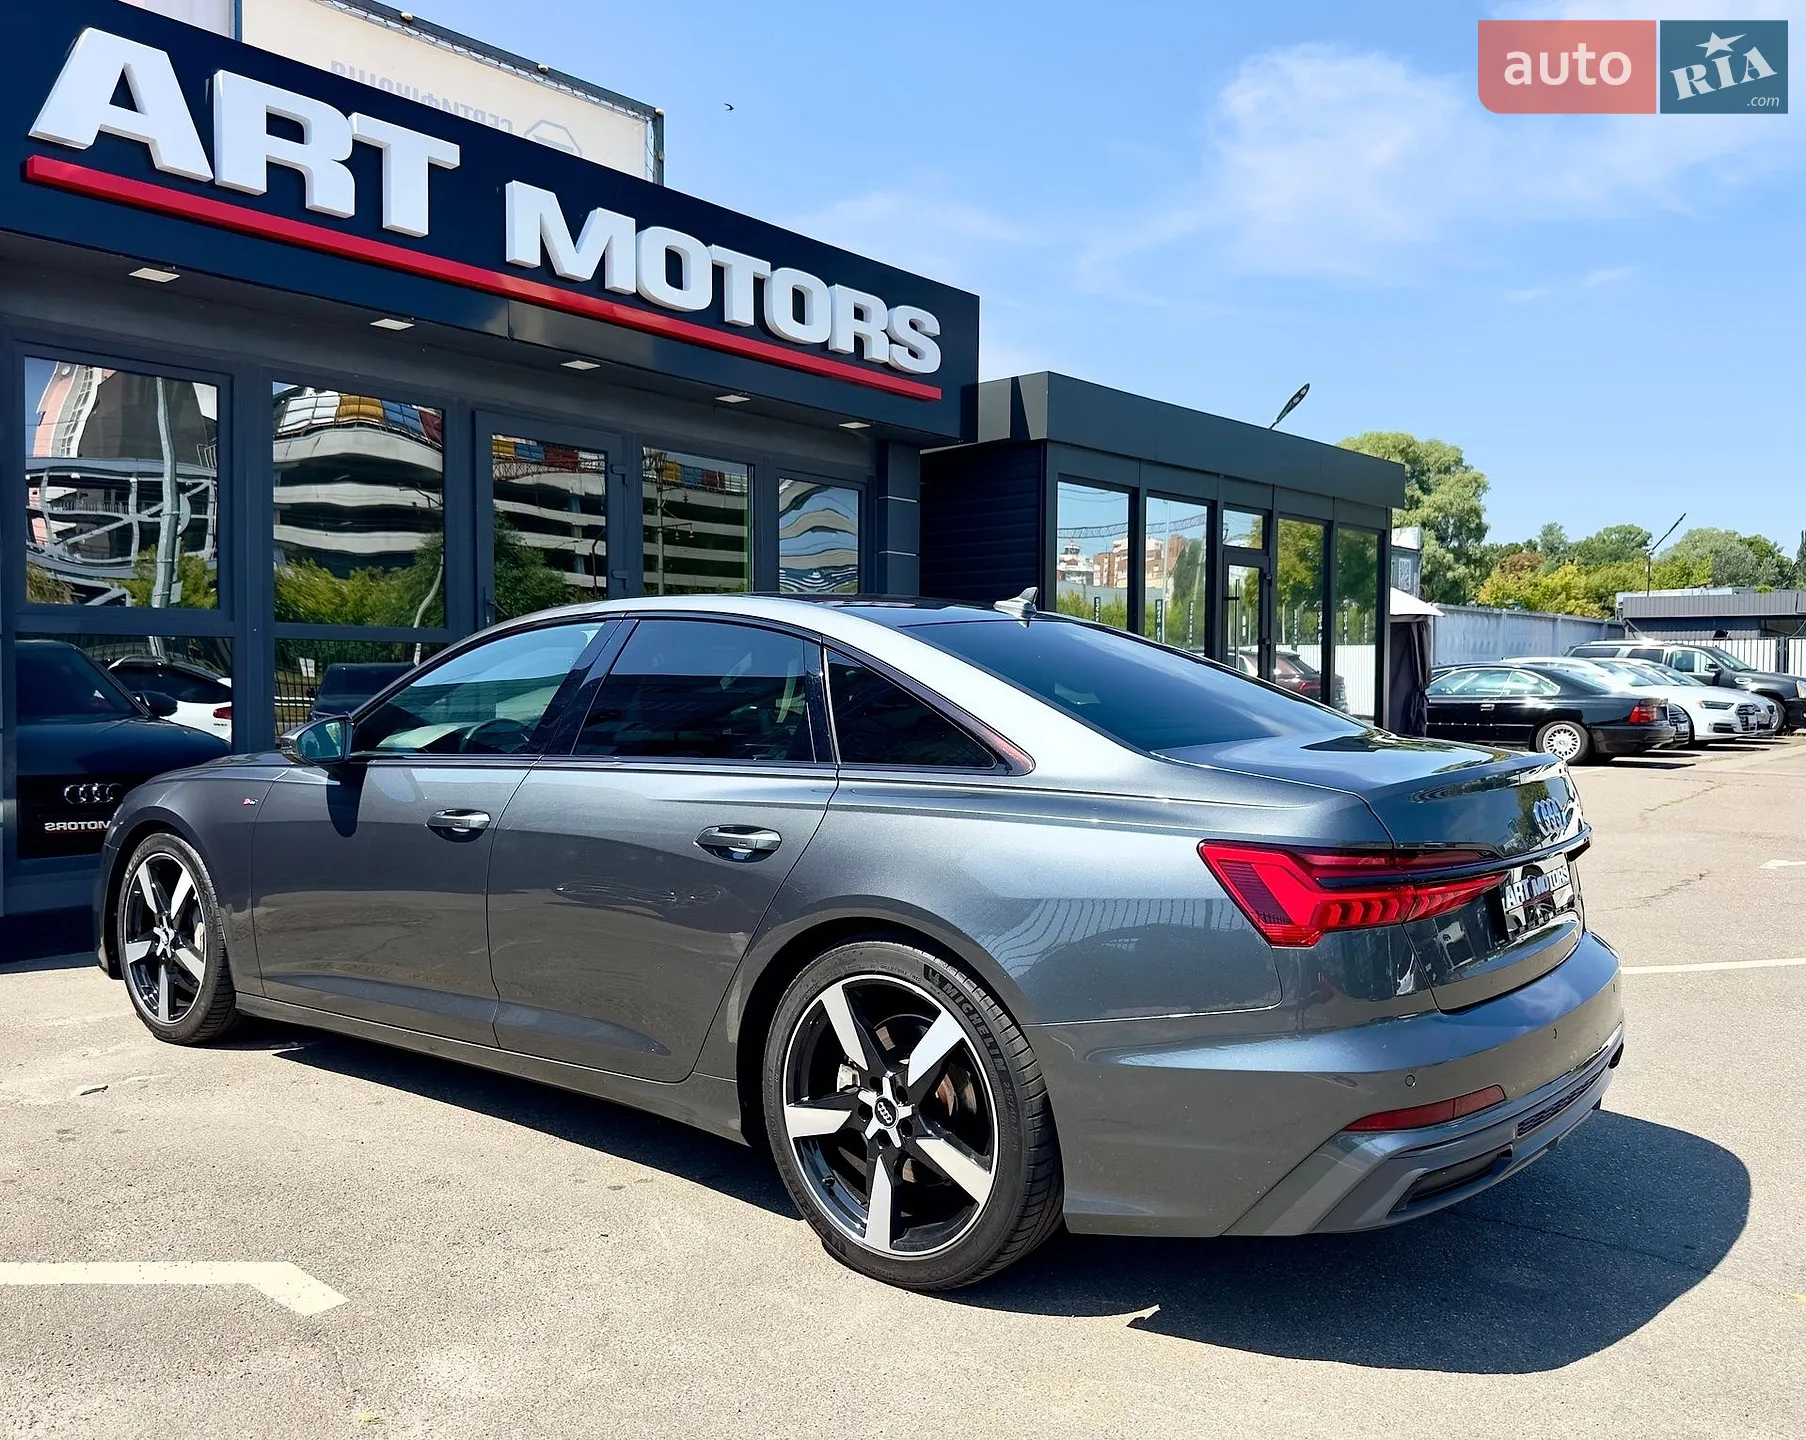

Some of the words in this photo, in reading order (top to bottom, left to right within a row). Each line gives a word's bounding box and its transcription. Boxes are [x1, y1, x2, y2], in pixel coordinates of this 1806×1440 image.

[28, 26, 460, 238] ART
[505, 179, 942, 375] MOTORS
[1505, 877, 1530, 909] ART
[1530, 866, 1569, 897] MOTORS
[941, 980, 1008, 1072] MICHELIN
